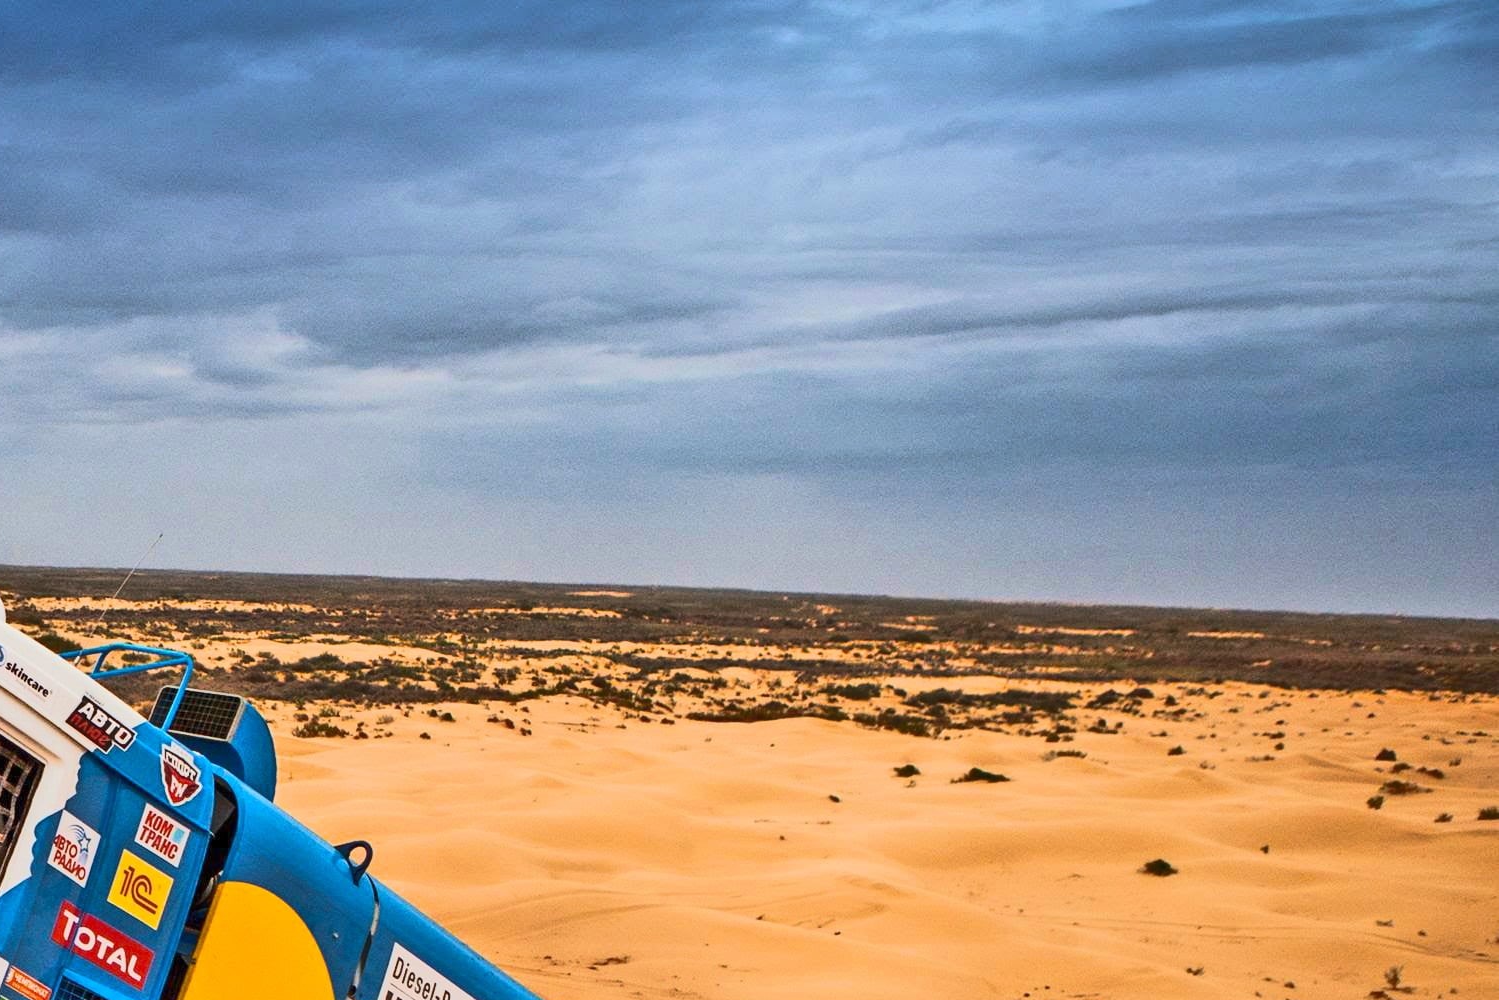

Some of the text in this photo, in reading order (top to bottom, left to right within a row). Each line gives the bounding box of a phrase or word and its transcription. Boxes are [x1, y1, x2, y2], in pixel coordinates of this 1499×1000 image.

[5, 661, 49, 698] skincare
[78, 701, 132, 745] АВТО
[145, 810, 174, 838] КОМ
[53, 833, 78, 857] АВТО
[138, 826, 180, 861] ТРАНС
[53, 849, 87, 881] РАДИО
[62, 909, 142, 982] TOTAL
